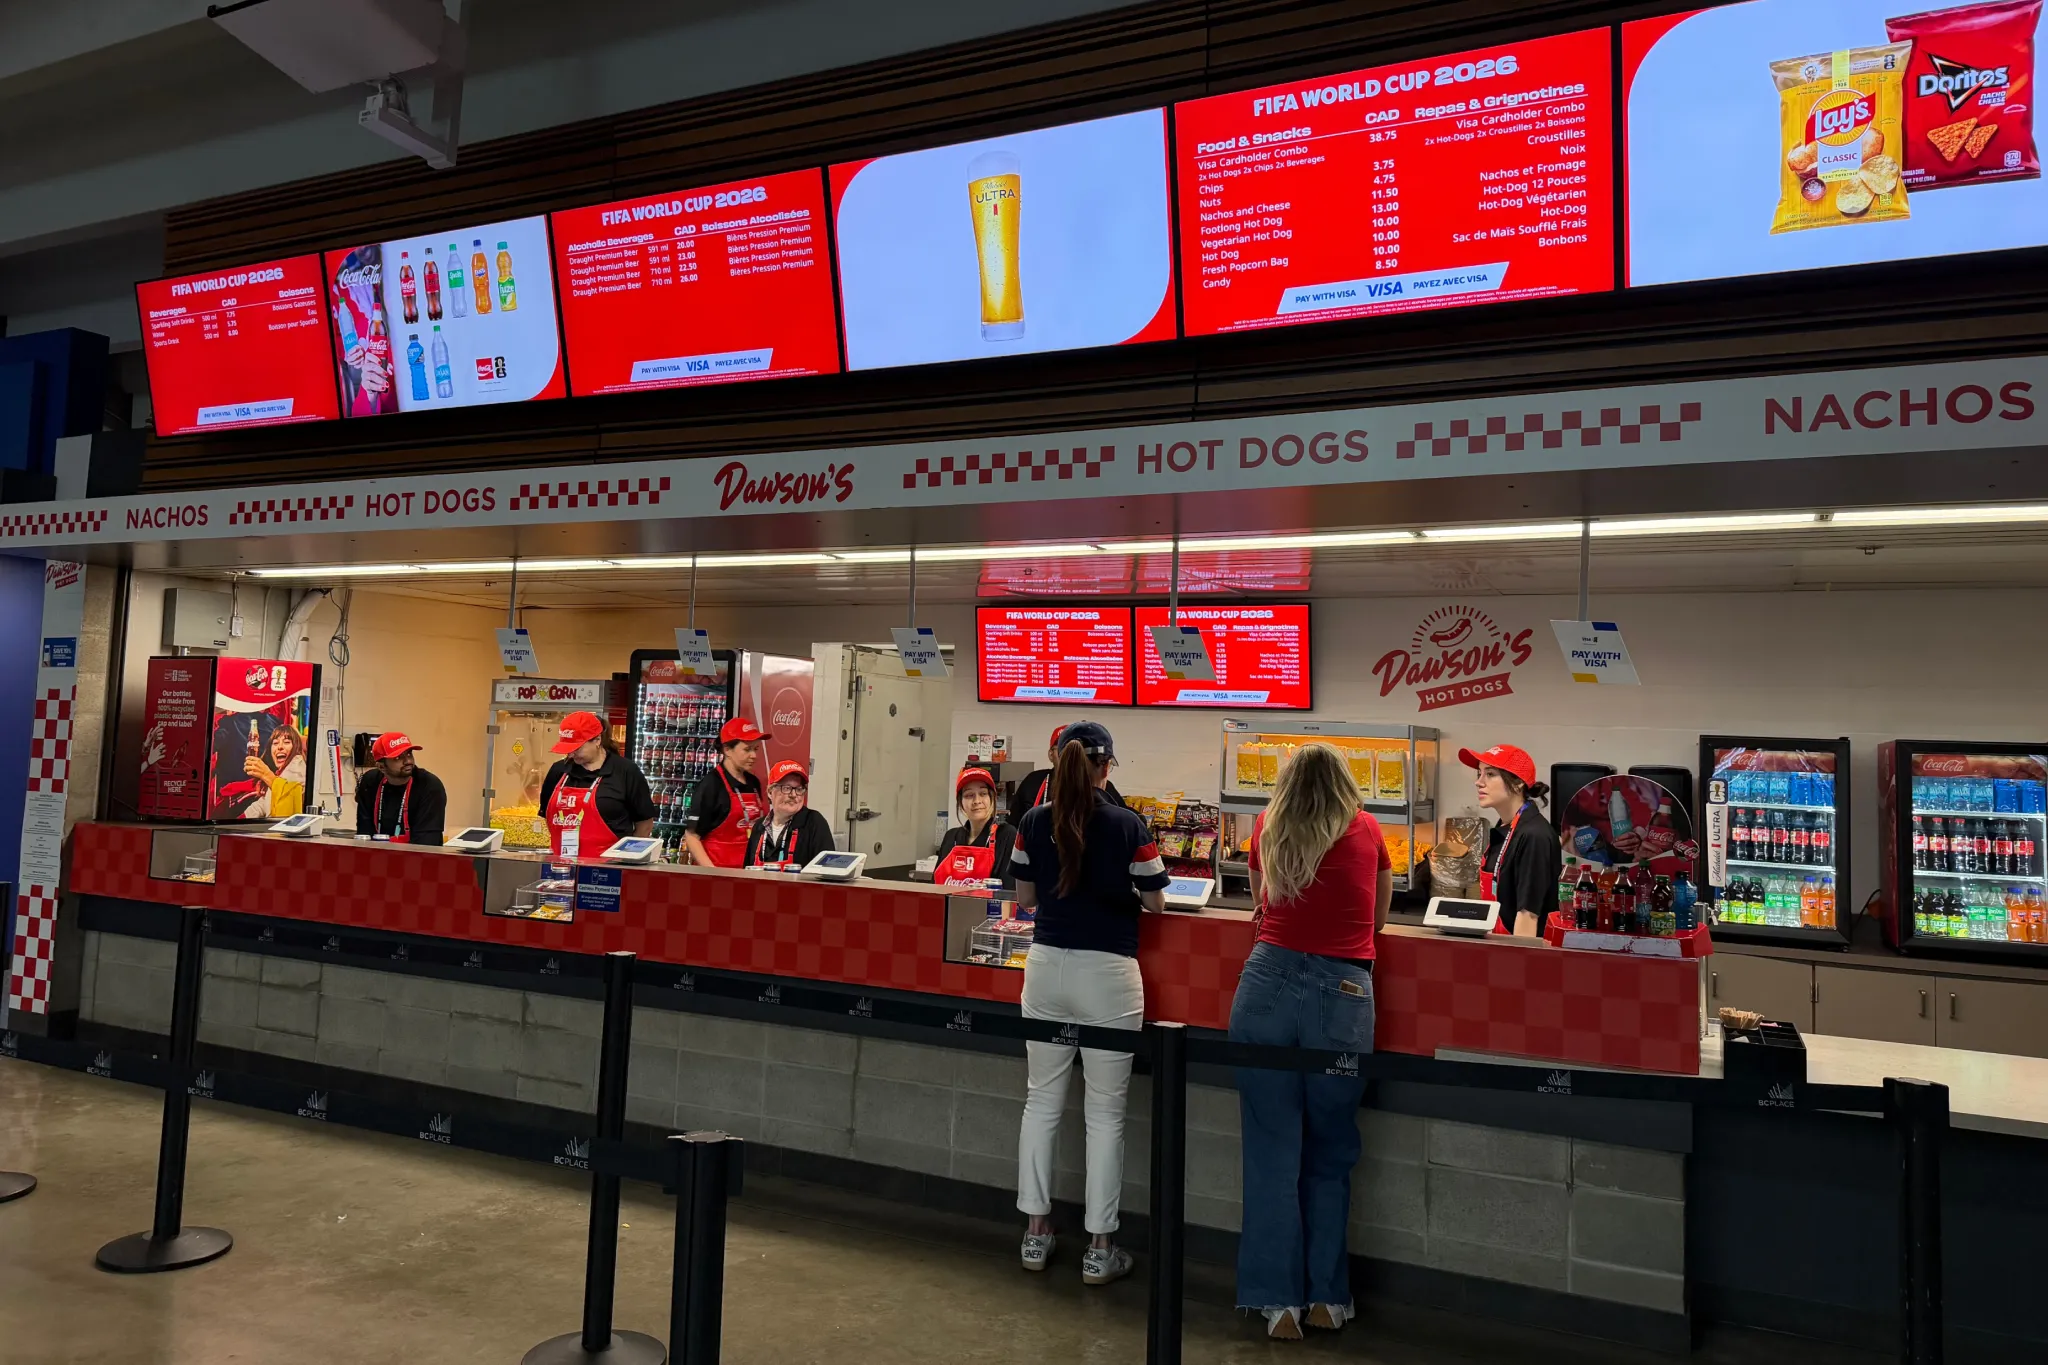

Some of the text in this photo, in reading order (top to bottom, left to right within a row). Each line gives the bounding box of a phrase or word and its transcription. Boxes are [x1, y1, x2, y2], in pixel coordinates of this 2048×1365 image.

[1254, 55, 1518, 117] FIFA WORLD CUP 2026
[1918, 67, 2008, 97] Doritos
[1415, 84, 1585, 119] Repas & Grignotines
[1978, 97, 2006, 106] CHEESE
[1979, 91, 2006, 100] NACHO
[1456, 103, 1585, 130] Visa Cardholder Combo
[1814, 99, 1869, 138] Lay's
[1197, 109, 1400, 154] Food & Snacks CAD
[1527, 128, 1586, 145] Croustilles
[1198, 130, 1397, 171] Visa Cardholder Combo 38.75
[1560, 144, 1586, 155] Noix
[1821, 152, 1858, 164] CLASSIC
[1198, 155, 1325, 181] 2x Hot Dogs 2x Chips 2x Beverages
[1199, 159, 1395, 195] Chips 3.75
[1480, 159, 1587, 181] Nachos et Fromage
[976, 188, 1016, 204] ULTRA
[1200, 174, 1395, 208] Nuts 4.75
[1483, 174, 1587, 196] Hot-Dog 12 Pouces
[601, 186, 766, 226] FIFA WORLD CUP 2026
[1200, 188, 1399, 222] Nachos and Cheese 11.50
[1478, 189, 1587, 211] Hot-Dog Végétarien
[1540, 204, 1587, 218] Hot-Dog
[701, 208, 810, 232] Boissons Alcoolisées
[1201, 202, 1399, 235] Footlong Hot Dog 13.00
[1453, 219, 1587, 243] Sac de Maïs Soufflé Frais
[567, 225, 696, 252] Alcoholic Beverages CAD
[726, 223, 811, 243] Bières Pression Premium
[1201, 216, 1400, 249] Vegetarian Hot Dog 10.00
[1538, 234, 1587, 247] Bonbons
[569, 240, 695, 265] Draught Premium Beer 20.00
[1202, 230, 1400, 262] Hot Dog 10.00
[1202, 244, 1400, 275] Fresh Popcorn Bag 10.00
[172, 267, 284, 297] FIFA WORLD CUP 2026
[339, 264, 381, 289] Coca-Cola
[1203, 258, 1398, 289] Candy 8.50
[1413, 274, 1488, 290] PAYEZ AVEC VISA
[278, 286, 315, 299] Boissons
[1295, 289, 1357, 304] PAY WITH VISA
[1365, 281, 1403, 298] VISA
[150, 298, 237, 318] Beverages CAD
[1765, 380, 2035, 434] NACHOS
[1137, 429, 1369, 474] HOT DOGS
[714, 459, 856, 511] Dawson's
[364, 486, 496, 518] HOT DOGS
[125, 504, 209, 531] NACHOS
[1371, 628, 1534, 697] Dawson's
[1571, 650, 1621, 661] PAY WITH
[1584, 659, 1608, 668] VISA
[173, 689, 192, 697] bottles
[1425, 680, 1504, 705] HOT DOGS
[773, 710, 802, 726] Coca-Cola
[1923, 758, 1966, 772] Coca-Cola
[1713, 810, 1721, 842] ULTRA
